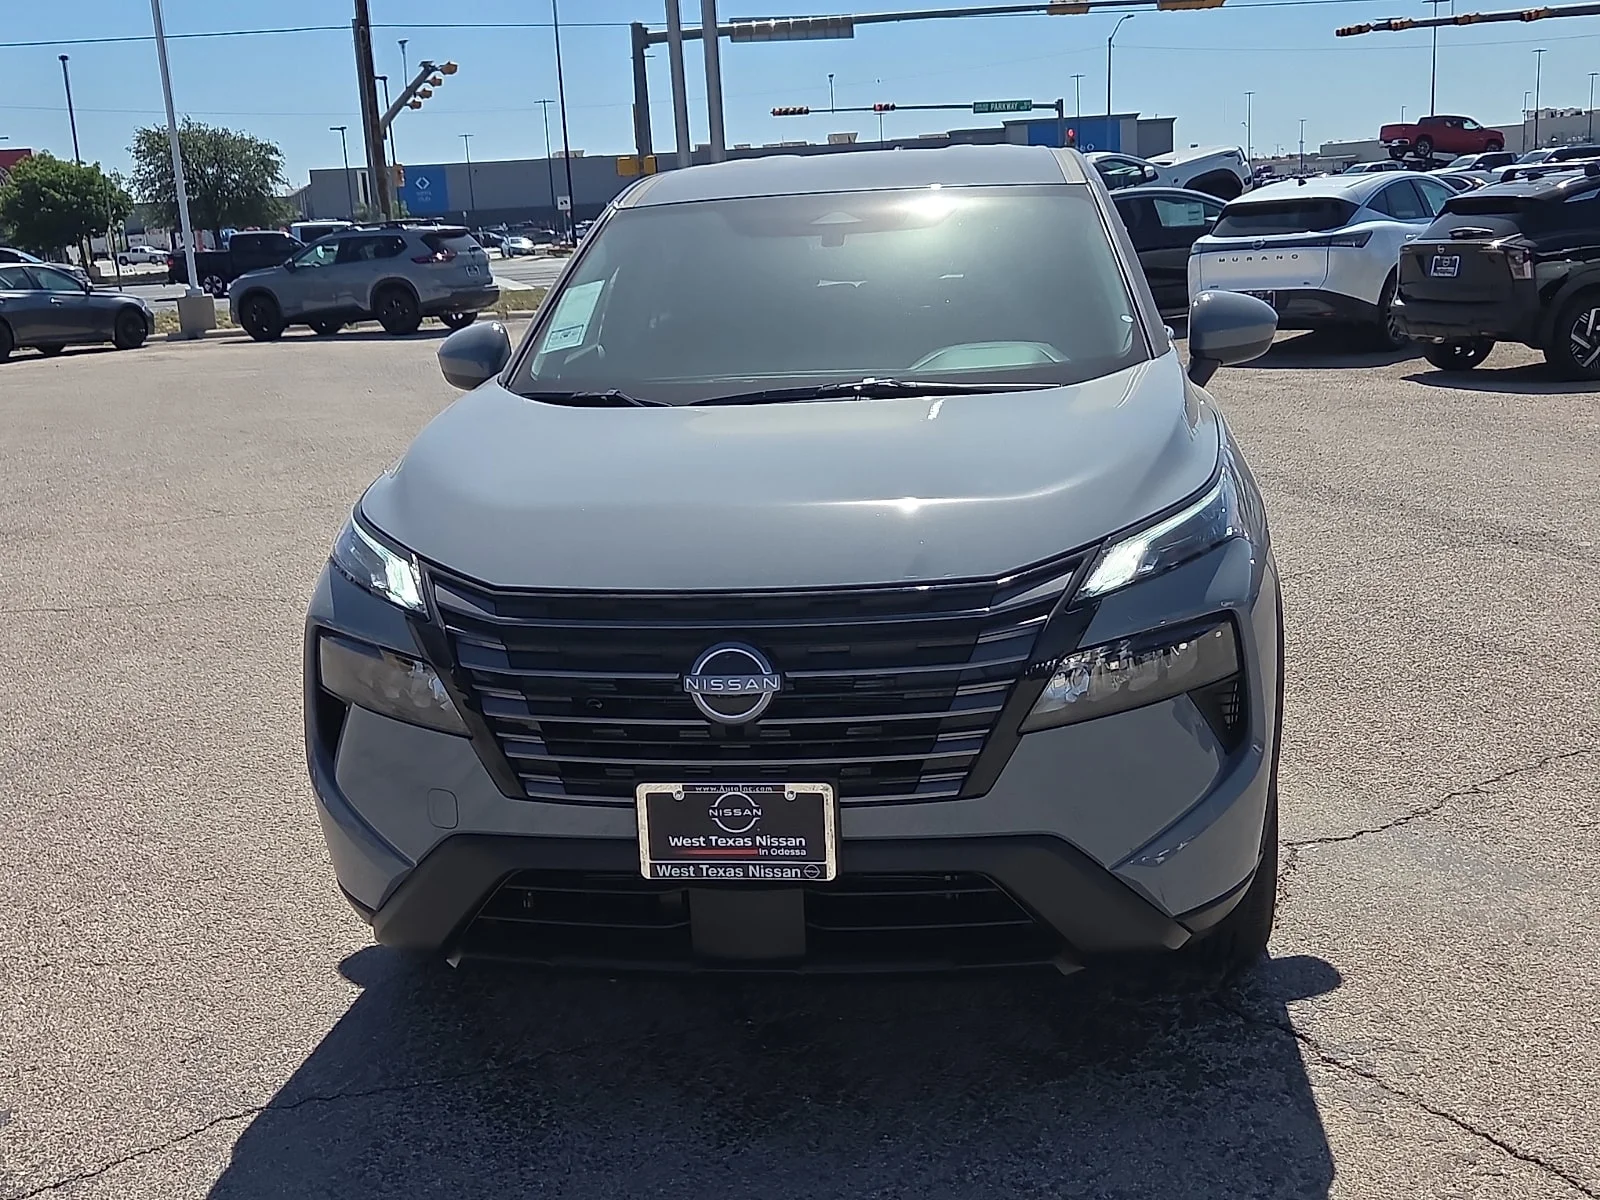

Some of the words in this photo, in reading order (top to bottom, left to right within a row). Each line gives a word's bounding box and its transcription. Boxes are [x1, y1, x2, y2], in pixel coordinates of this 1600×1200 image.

[990, 102, 1018, 111] PARKWAY
[1218, 253, 1299, 263] MURANO
[685, 676, 778, 691] NISSAN
[708, 808, 763, 817] NISSAN
[668, 836, 706, 847] West
[709, 836, 752, 847] Texas
[756, 835, 806, 847] Nissan
[758, 848, 769, 856] In
[770, 848, 807, 856] Odessa
[656, 865, 696, 877] West
[699, 865, 744, 878] Texas
[748, 865, 801, 878] Nissan
